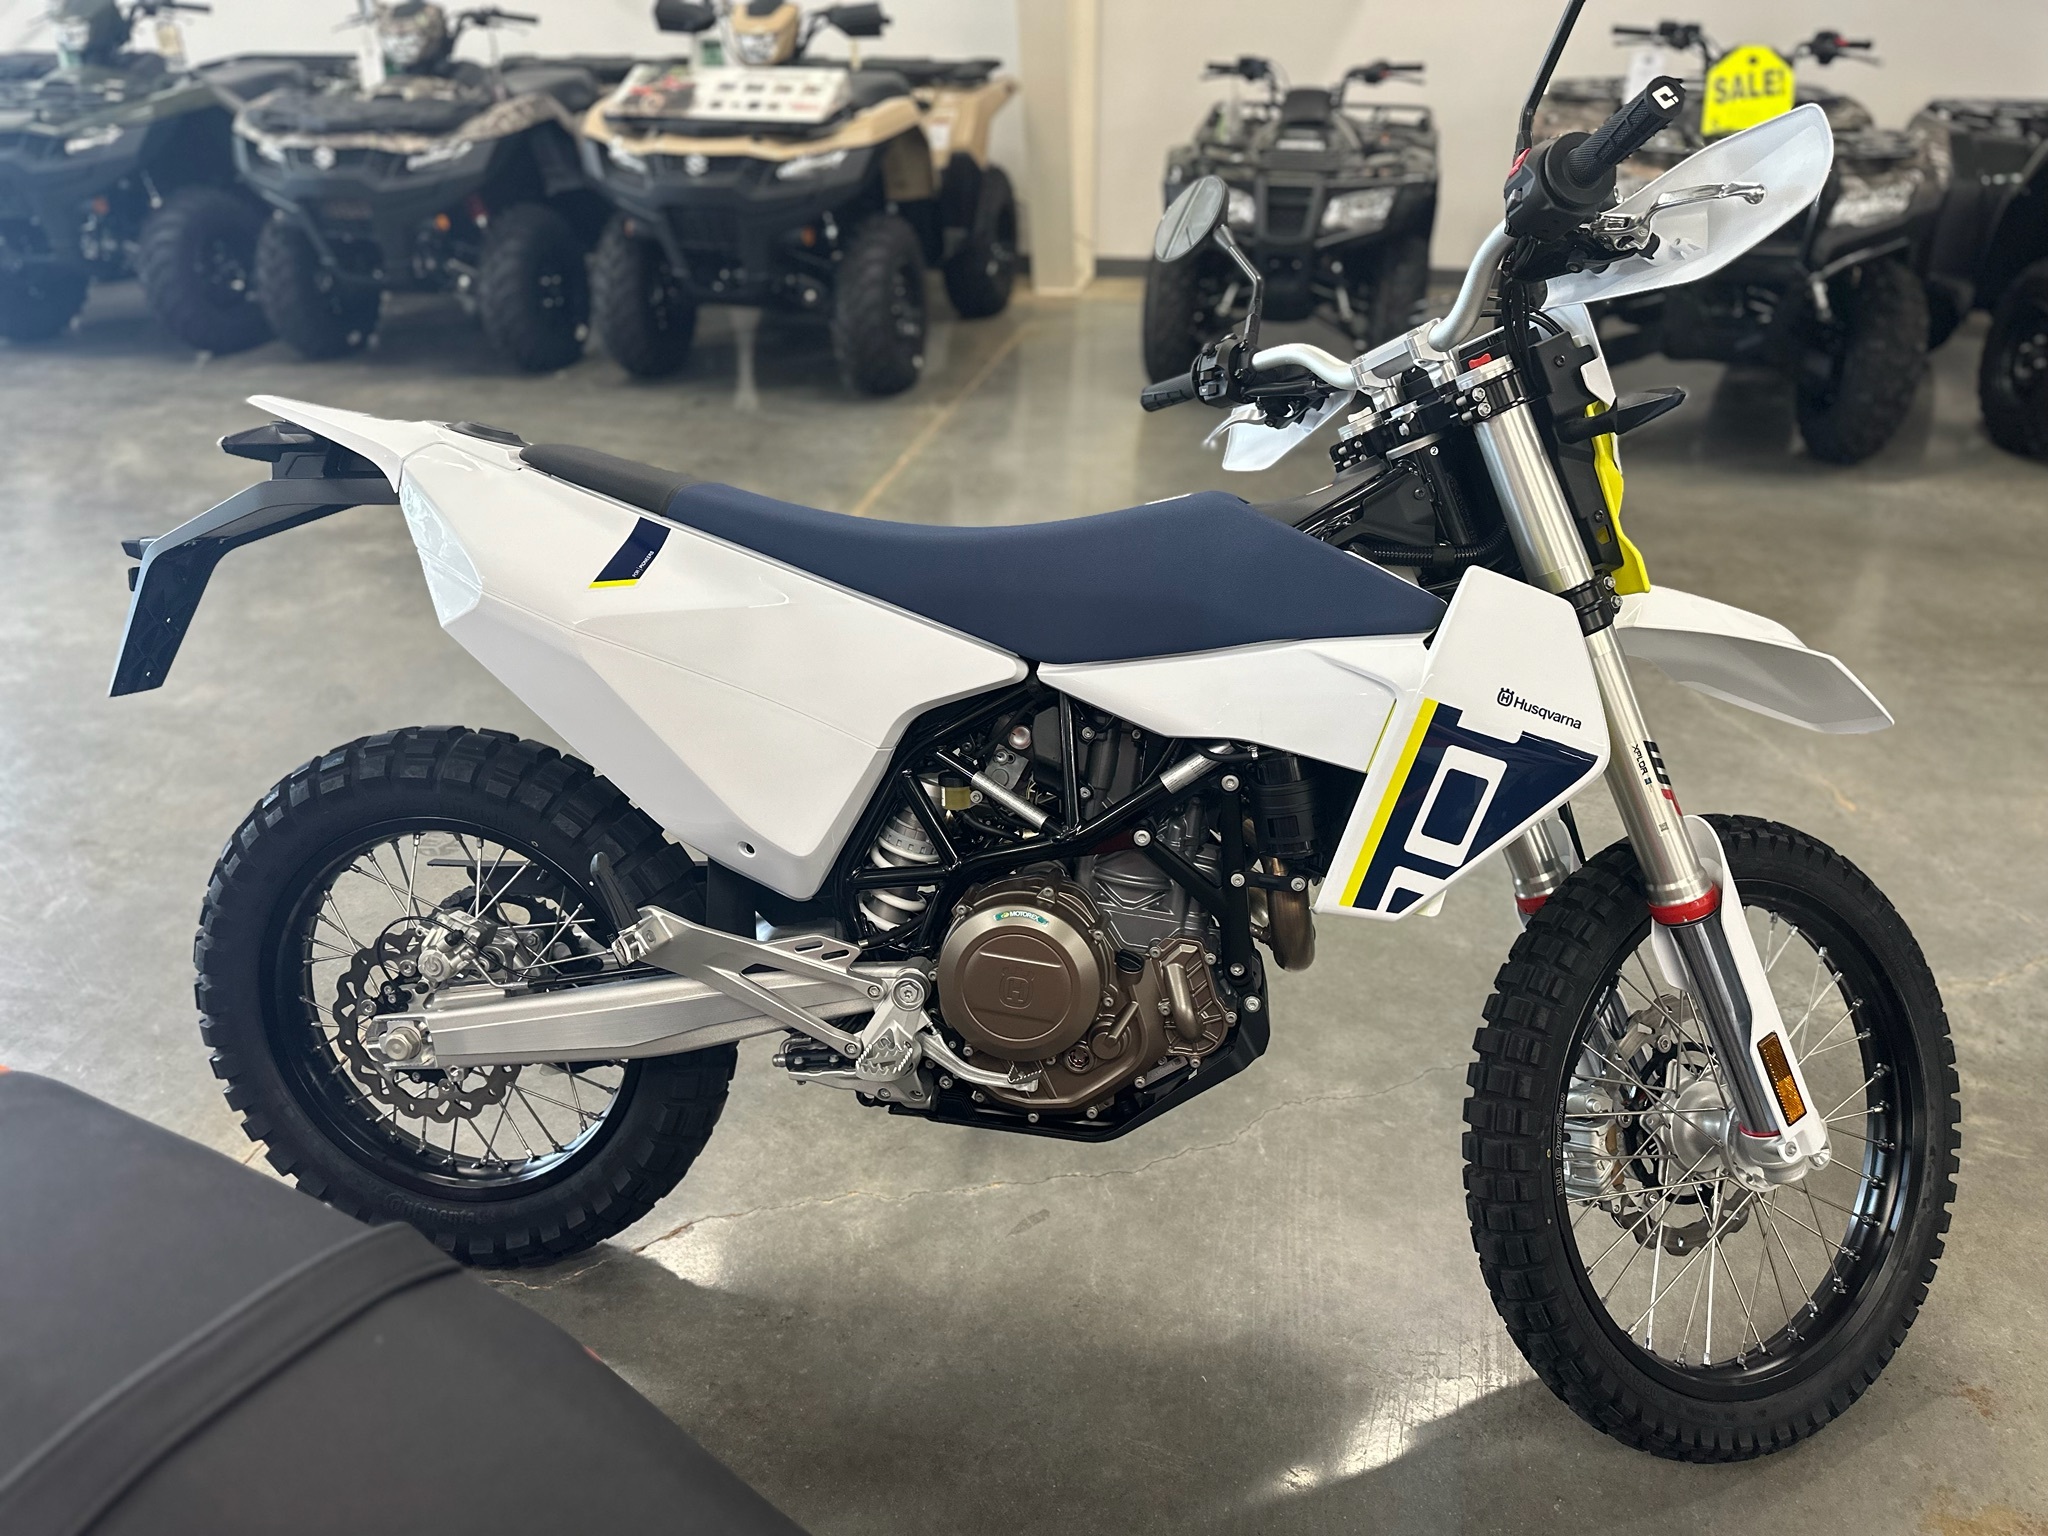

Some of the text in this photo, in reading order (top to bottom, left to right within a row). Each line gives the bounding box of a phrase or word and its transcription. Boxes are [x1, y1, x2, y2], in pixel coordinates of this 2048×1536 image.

[1513, 696, 1582, 730] Husqvarna
[1631, 744, 1649, 776] XPLOR
[1009, 910, 1039, 922] MOTOREX
